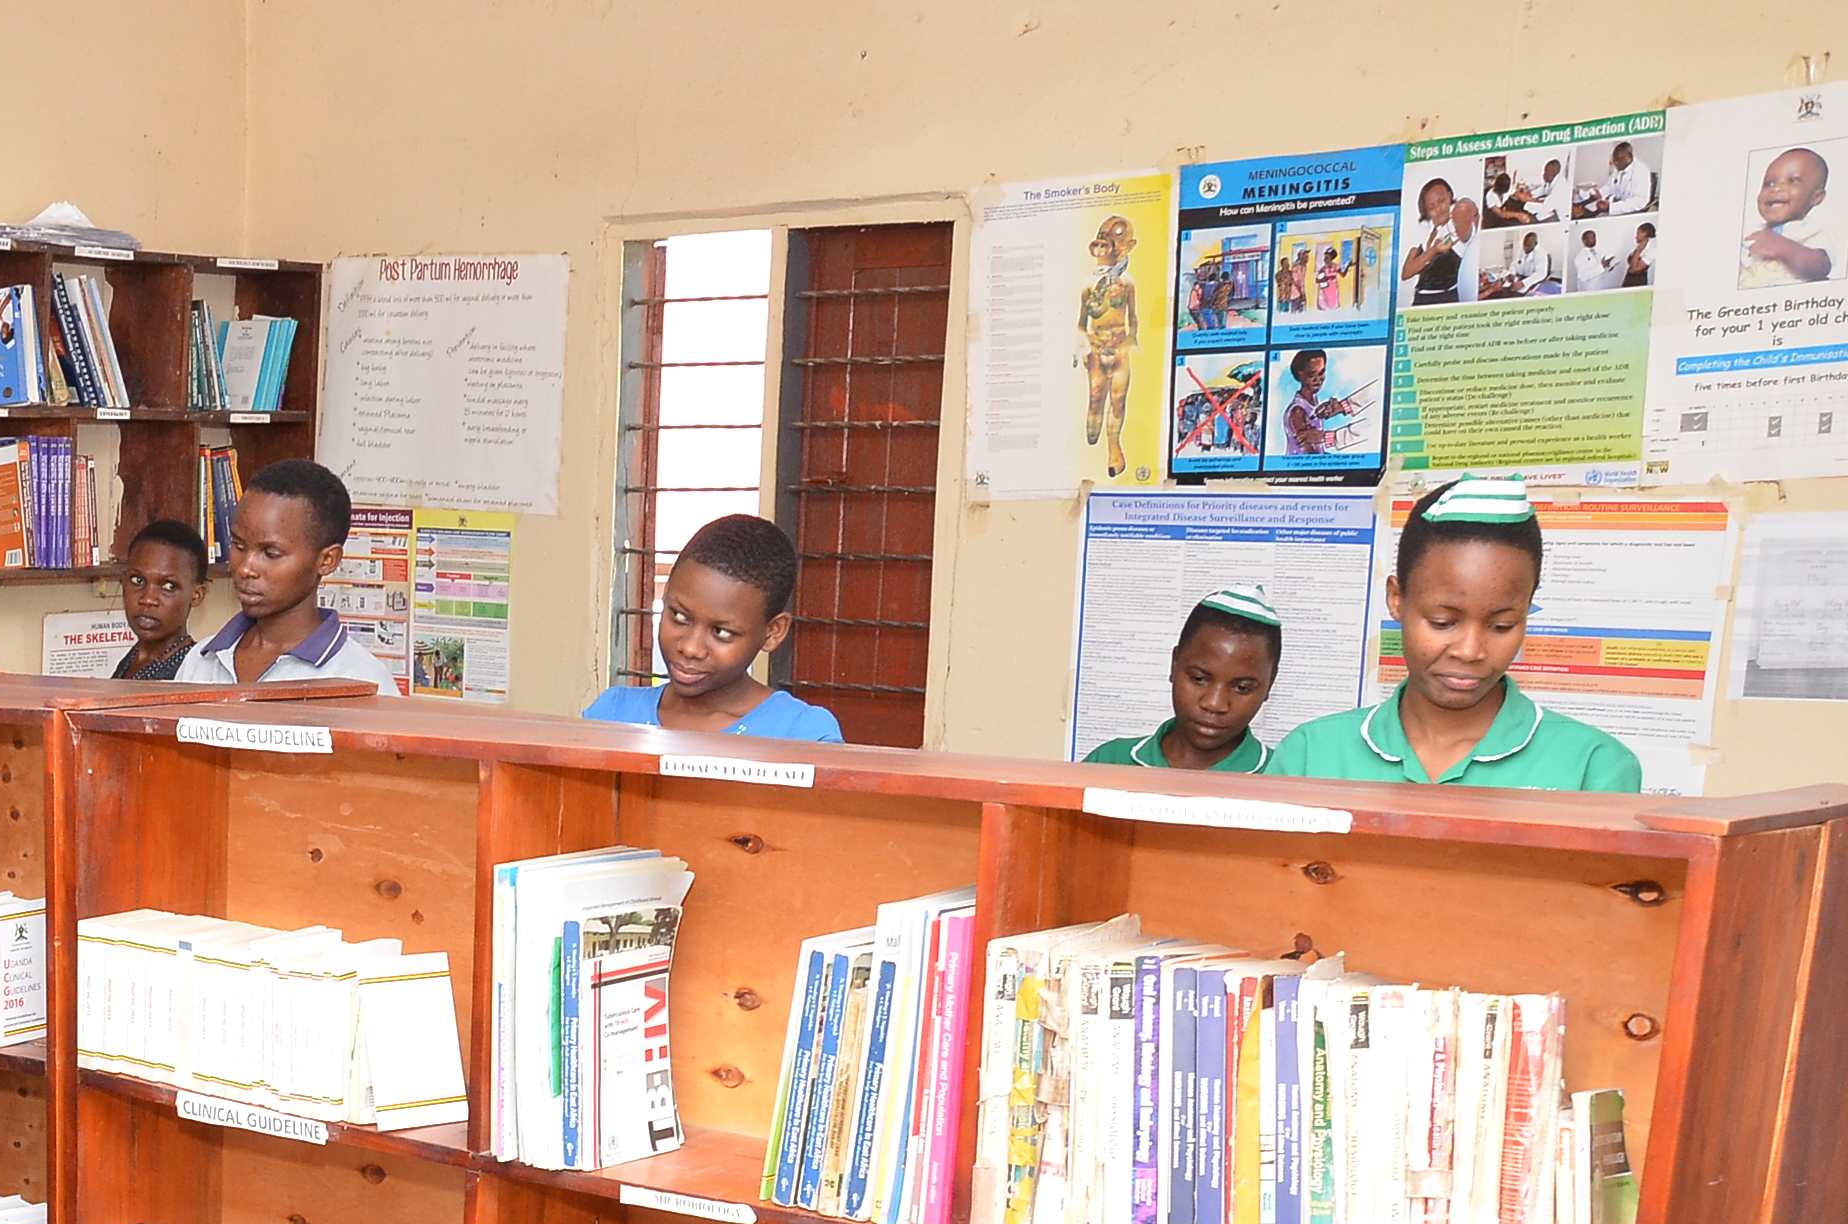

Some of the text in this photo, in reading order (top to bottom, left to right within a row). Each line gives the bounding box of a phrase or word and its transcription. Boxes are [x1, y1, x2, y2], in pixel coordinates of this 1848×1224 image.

[1410, 113, 1665, 160] Steps to Assess Adverse Drug Reaction (ADR)
[1248, 161, 1356, 181] MENINGOCOCCAL
[1024, 182, 1120, 201] The Smoker's Body
[1242, 177, 1351, 200] MENINGITIS
[1219, 195, 1356, 217] How can Meningitis be prevented?
[379, 257, 519, 285] Post Partum Hemorrhage
[1687, 295, 1844, 320] The Greatest Birthday
[1695, 313, 1829, 338] for your 1 year old
[1772, 335, 1783, 346] is
[1678, 353, 1788, 373] Completing the Child's
[1694, 381, 1712, 392] five
[1717, 379, 1742, 390] times
[1746, 376, 1779, 388] before
[1784, 375, 1806, 386] first
[1112, 500, 1349, 513] Case Definitions for Priority diseases and events for
[379, 511, 410, 526] Injection
[1124, 513, 1335, 525] Integrated Disease Surveillance and Response
[63, 631, 135, 645] THE SKELETAL
[178, 721, 326, 748] CLINICAL GUIDELINE
[4, 957, 33, 970] UGANDA
[4, 983, 41, 997] GUIDELINES
[4, 997, 24, 1010] 2016
[934, 951, 959, 1136] Primary Mother Care and Population
[794, 1081, 808, 1118] Healthcare
[183, 1099, 322, 1141] CLINICAL GUIDELINE
[858, 1061, 884, 1179] Primary Healthcare East Africa
[1310, 1047, 1331, 1195] Anatomy and Physiology
